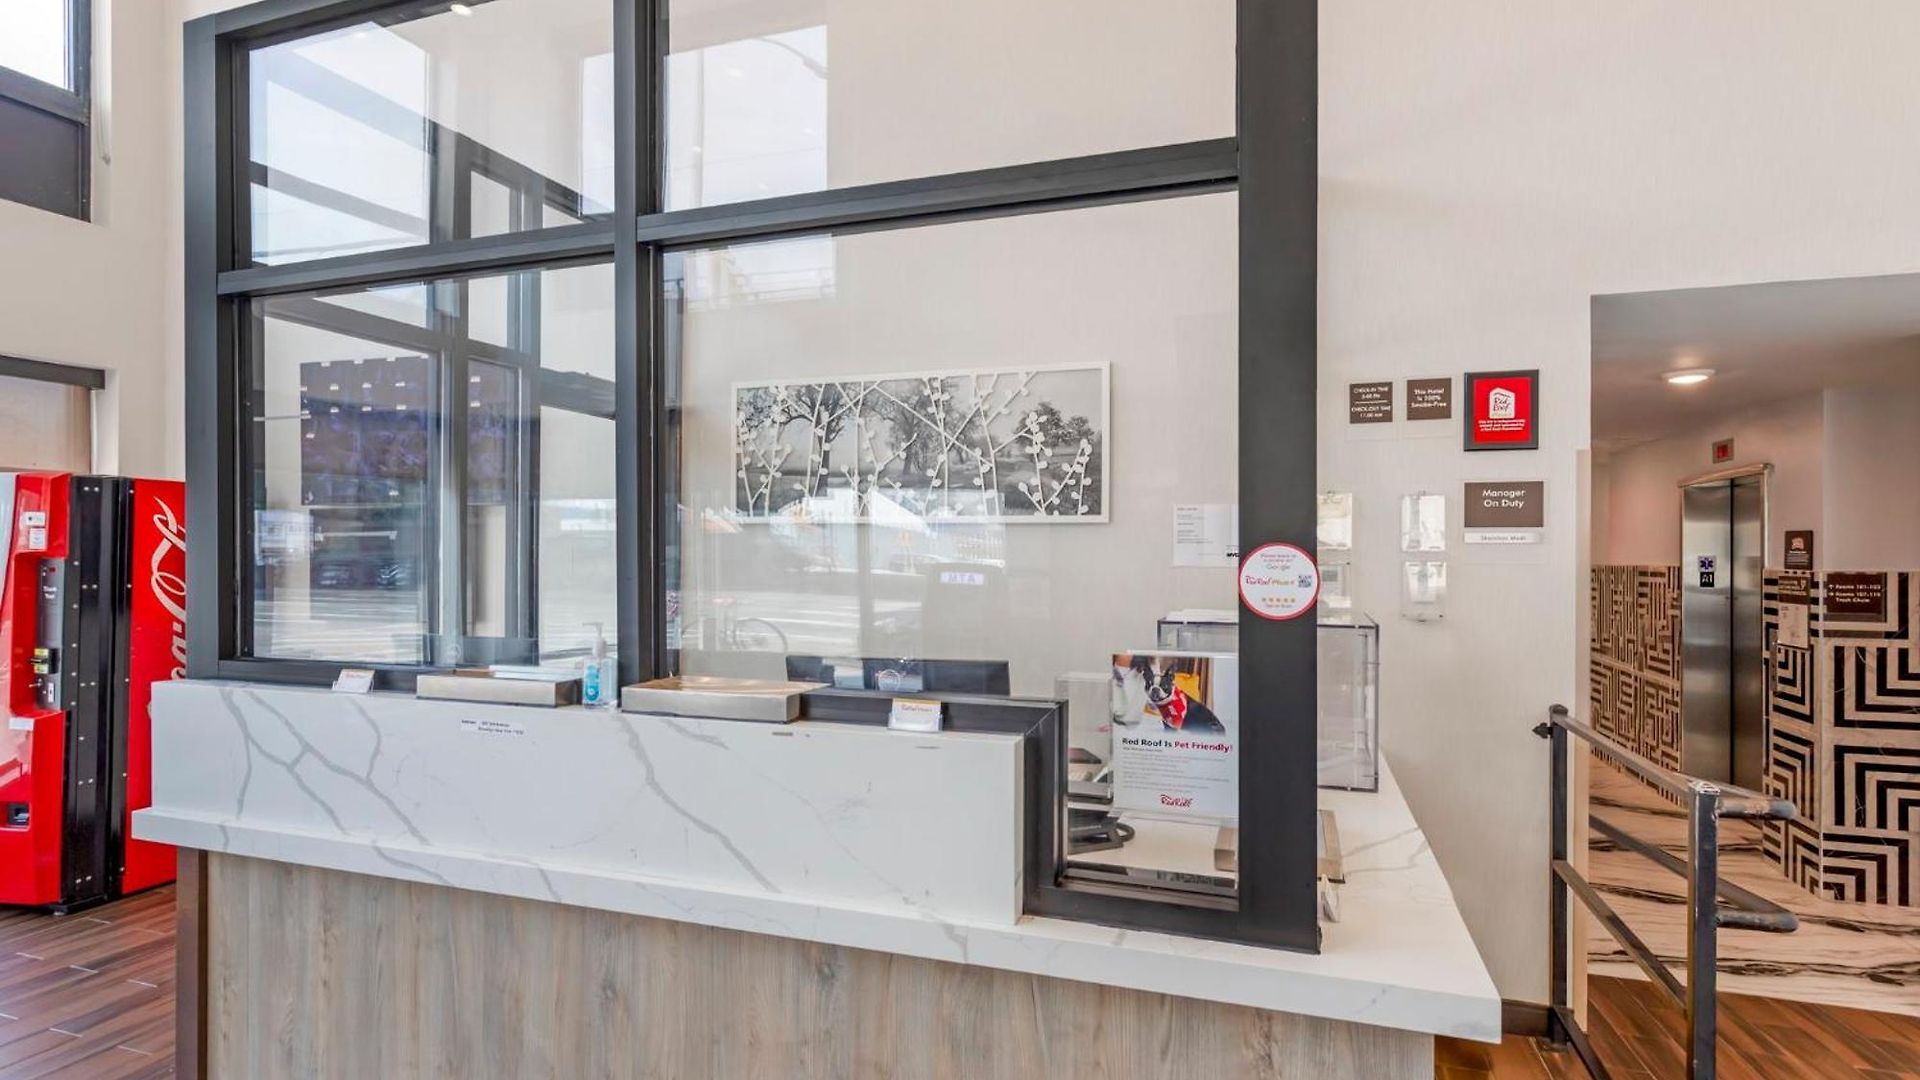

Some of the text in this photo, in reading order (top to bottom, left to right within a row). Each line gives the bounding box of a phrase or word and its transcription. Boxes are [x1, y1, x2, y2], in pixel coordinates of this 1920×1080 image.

[1482, 489, 1526, 499] Manager
[1483, 499, 1524, 509] On Duty
[1265, 563, 1291, 571] Google
[1122, 737, 1233, 753] Red Roof Is Pet Friendly!
